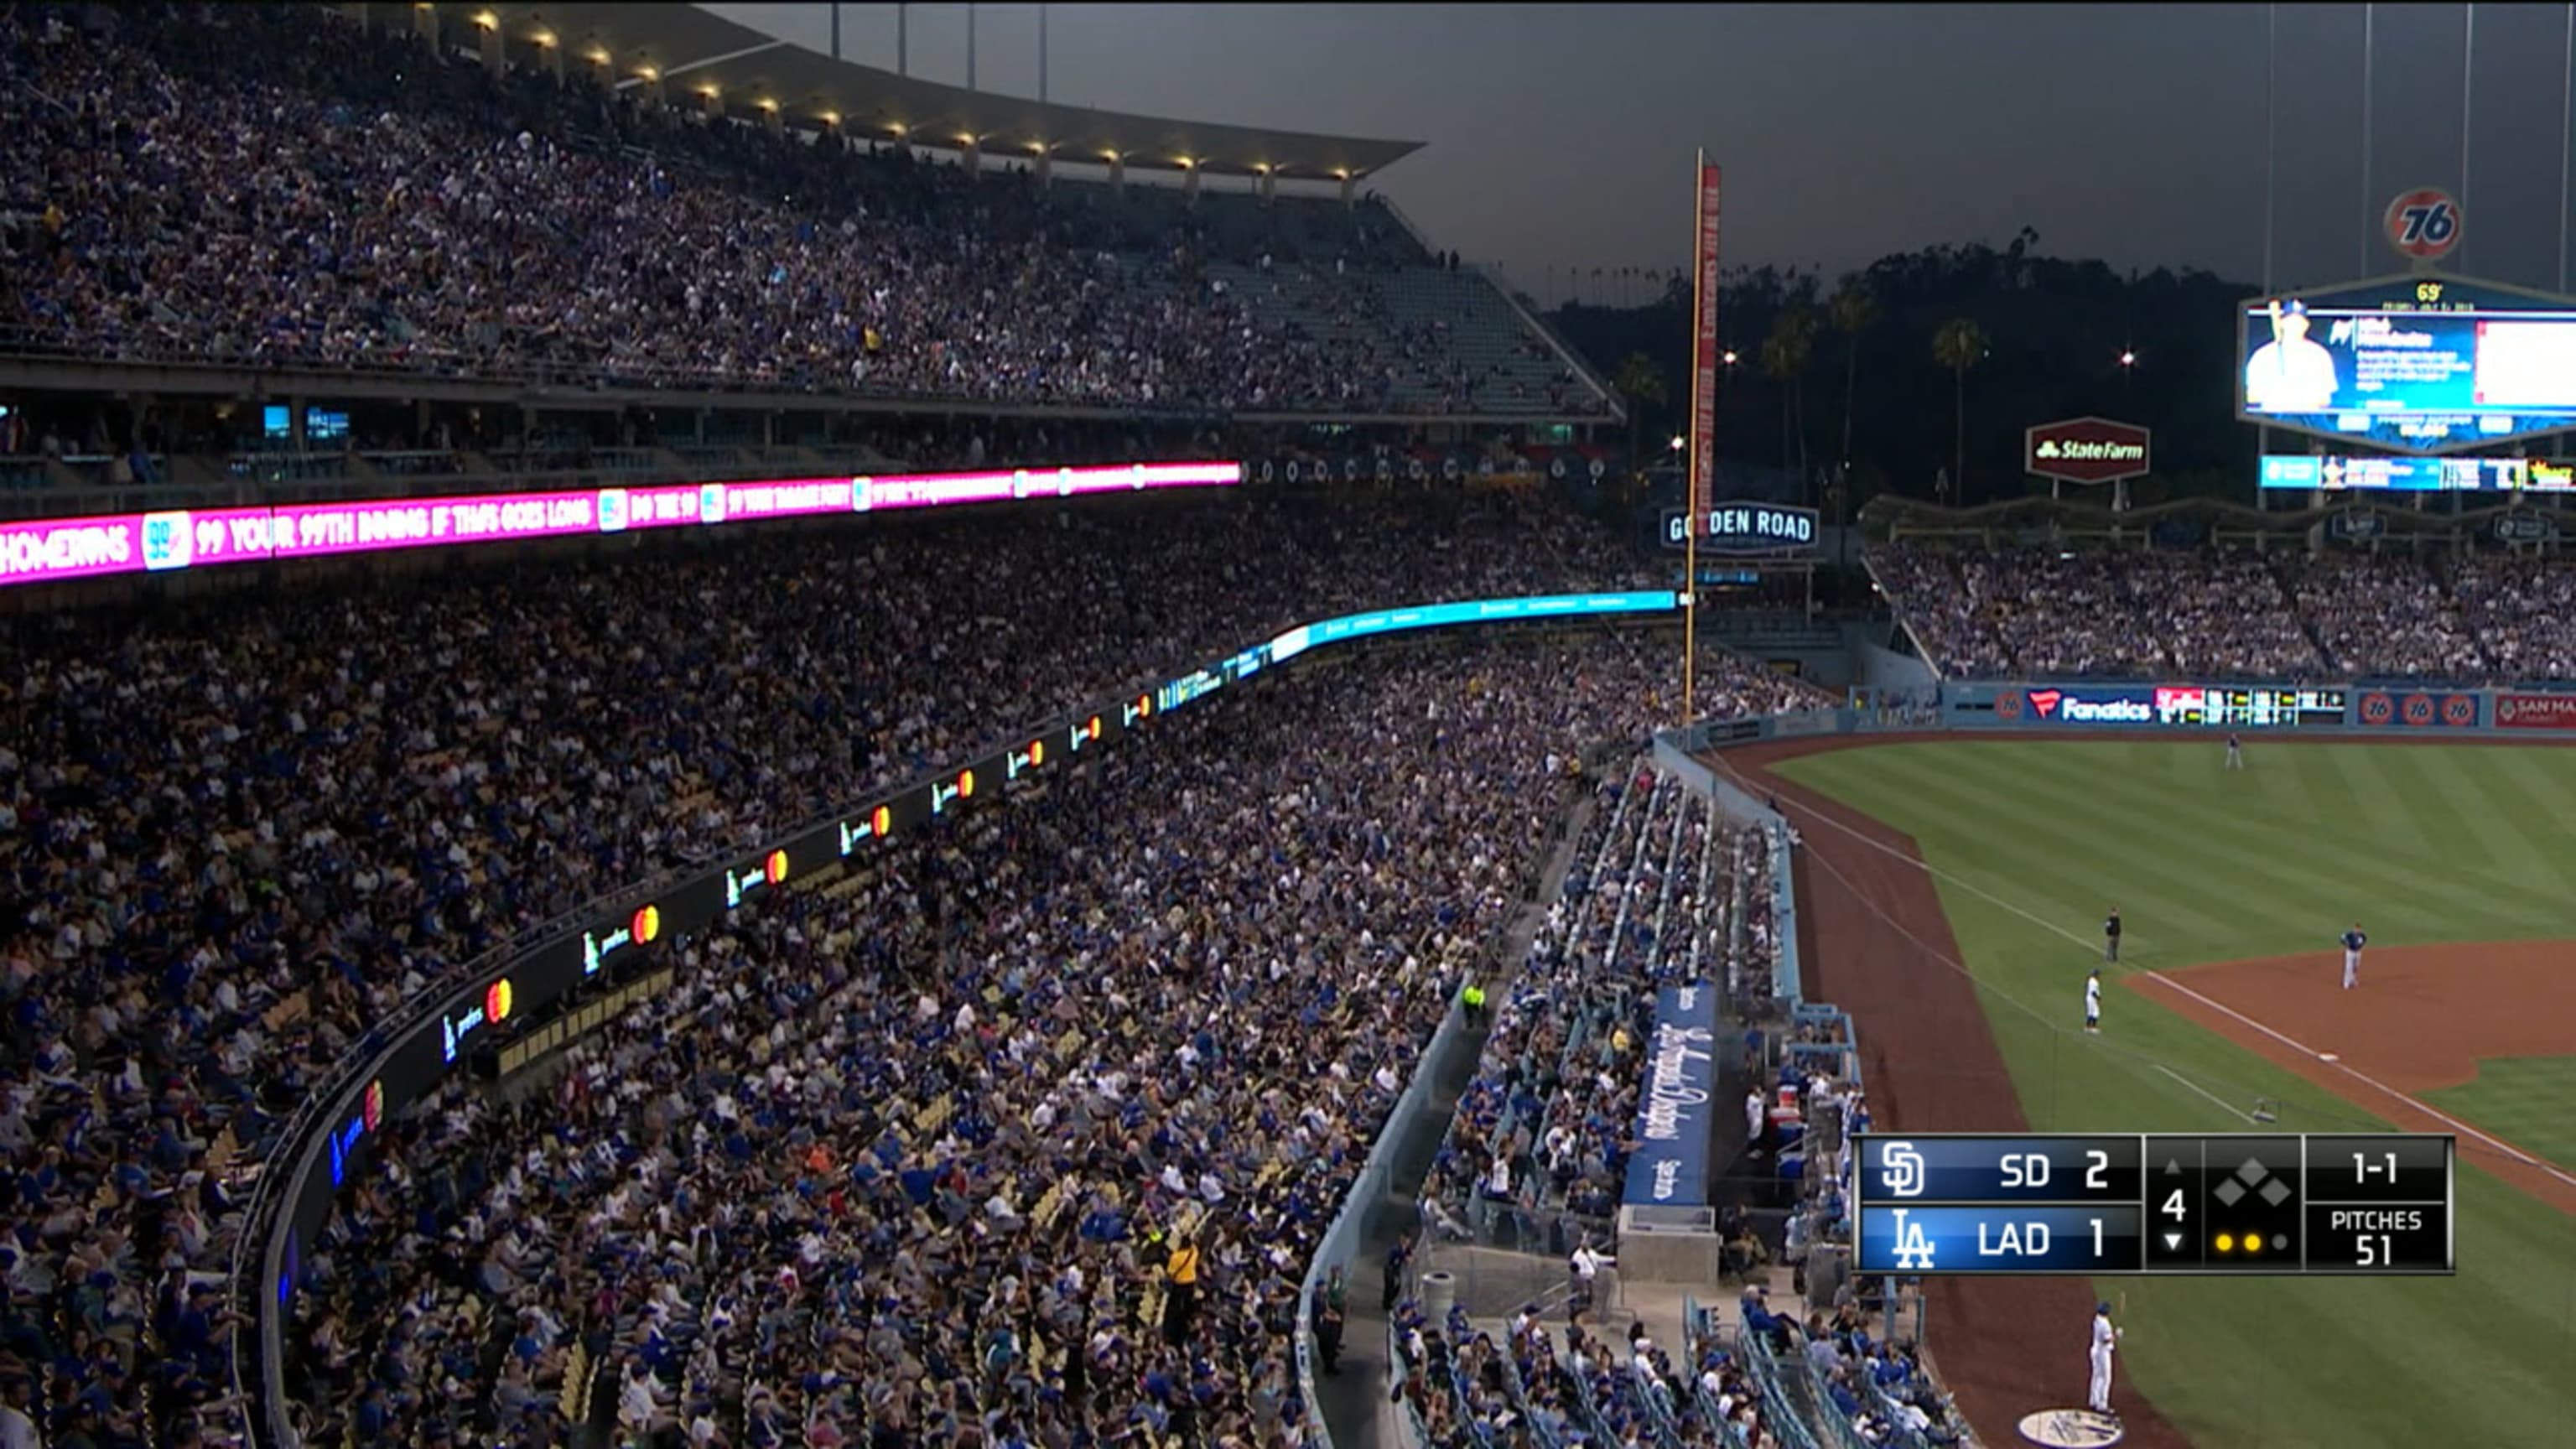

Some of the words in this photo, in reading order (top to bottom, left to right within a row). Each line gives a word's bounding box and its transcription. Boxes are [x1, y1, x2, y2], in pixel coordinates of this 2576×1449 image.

[2399, 203, 2454, 245] 76
[228, 515, 293, 553] YOUR
[1670, 510, 1750, 541] GODEN
[1758, 510, 1811, 542] ROAD
[2062, 698, 2152, 721] Fanatics
[2517, 699, 2548, 713] SAN
